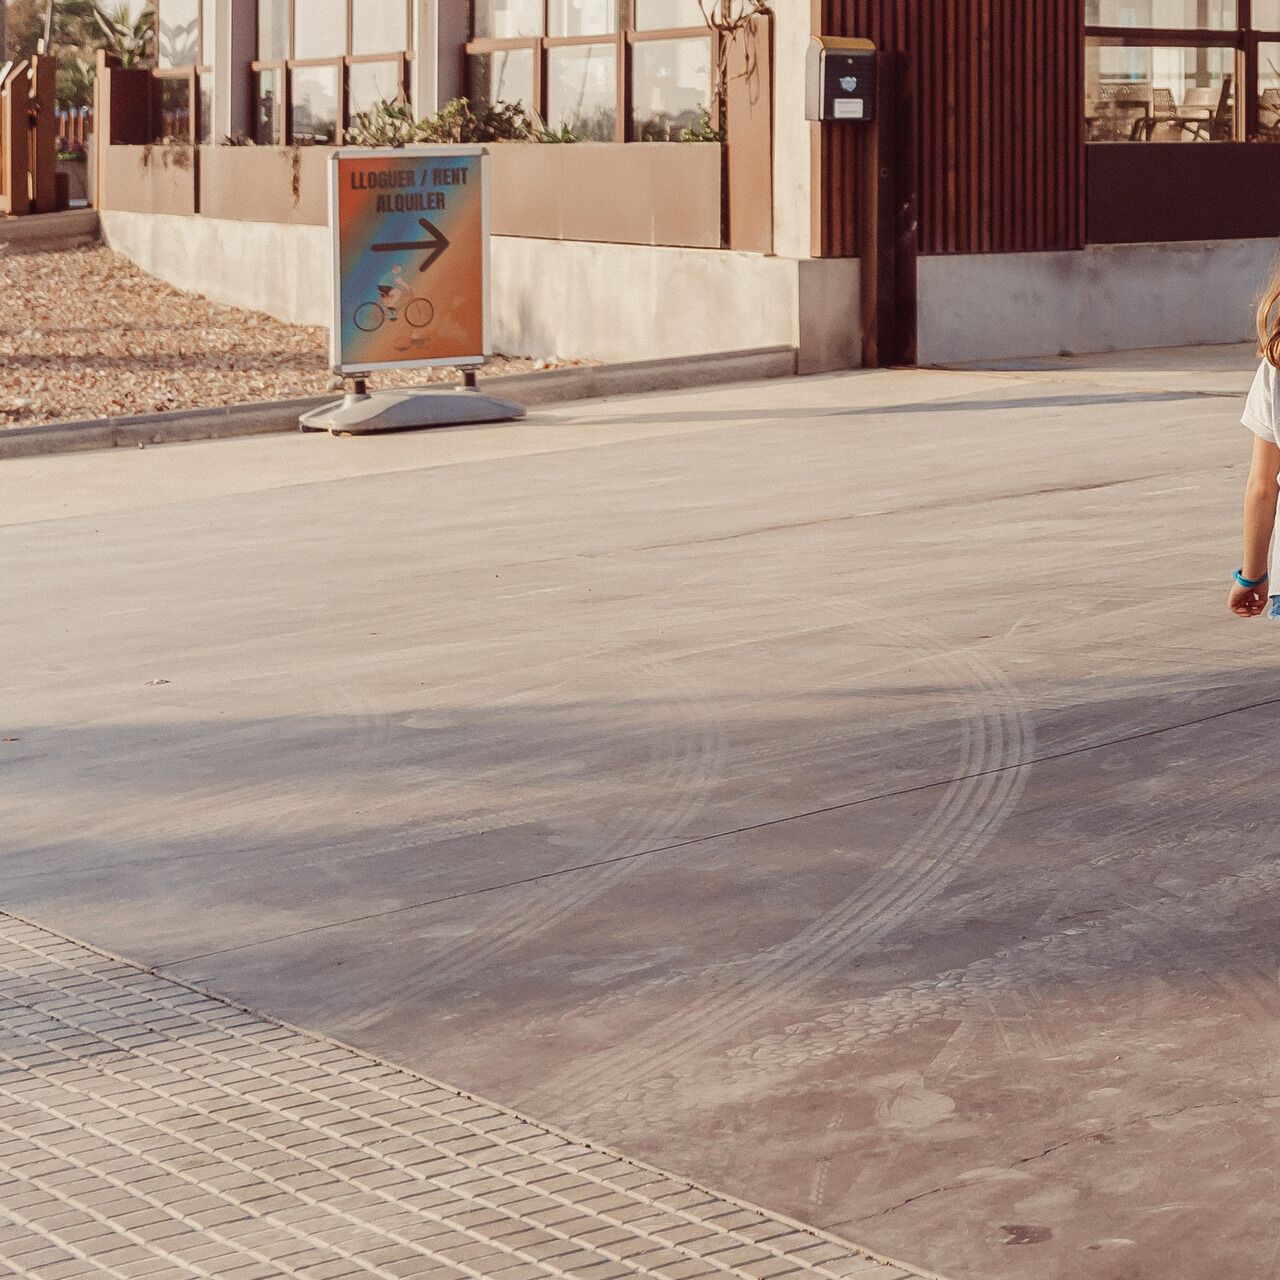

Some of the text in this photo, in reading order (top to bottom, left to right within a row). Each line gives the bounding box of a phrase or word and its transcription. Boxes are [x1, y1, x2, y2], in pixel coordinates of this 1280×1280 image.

[350, 169, 416, 190] LLOGUER
[432, 166, 469, 186] RENT
[376, 191, 446, 214] ALQUILER
